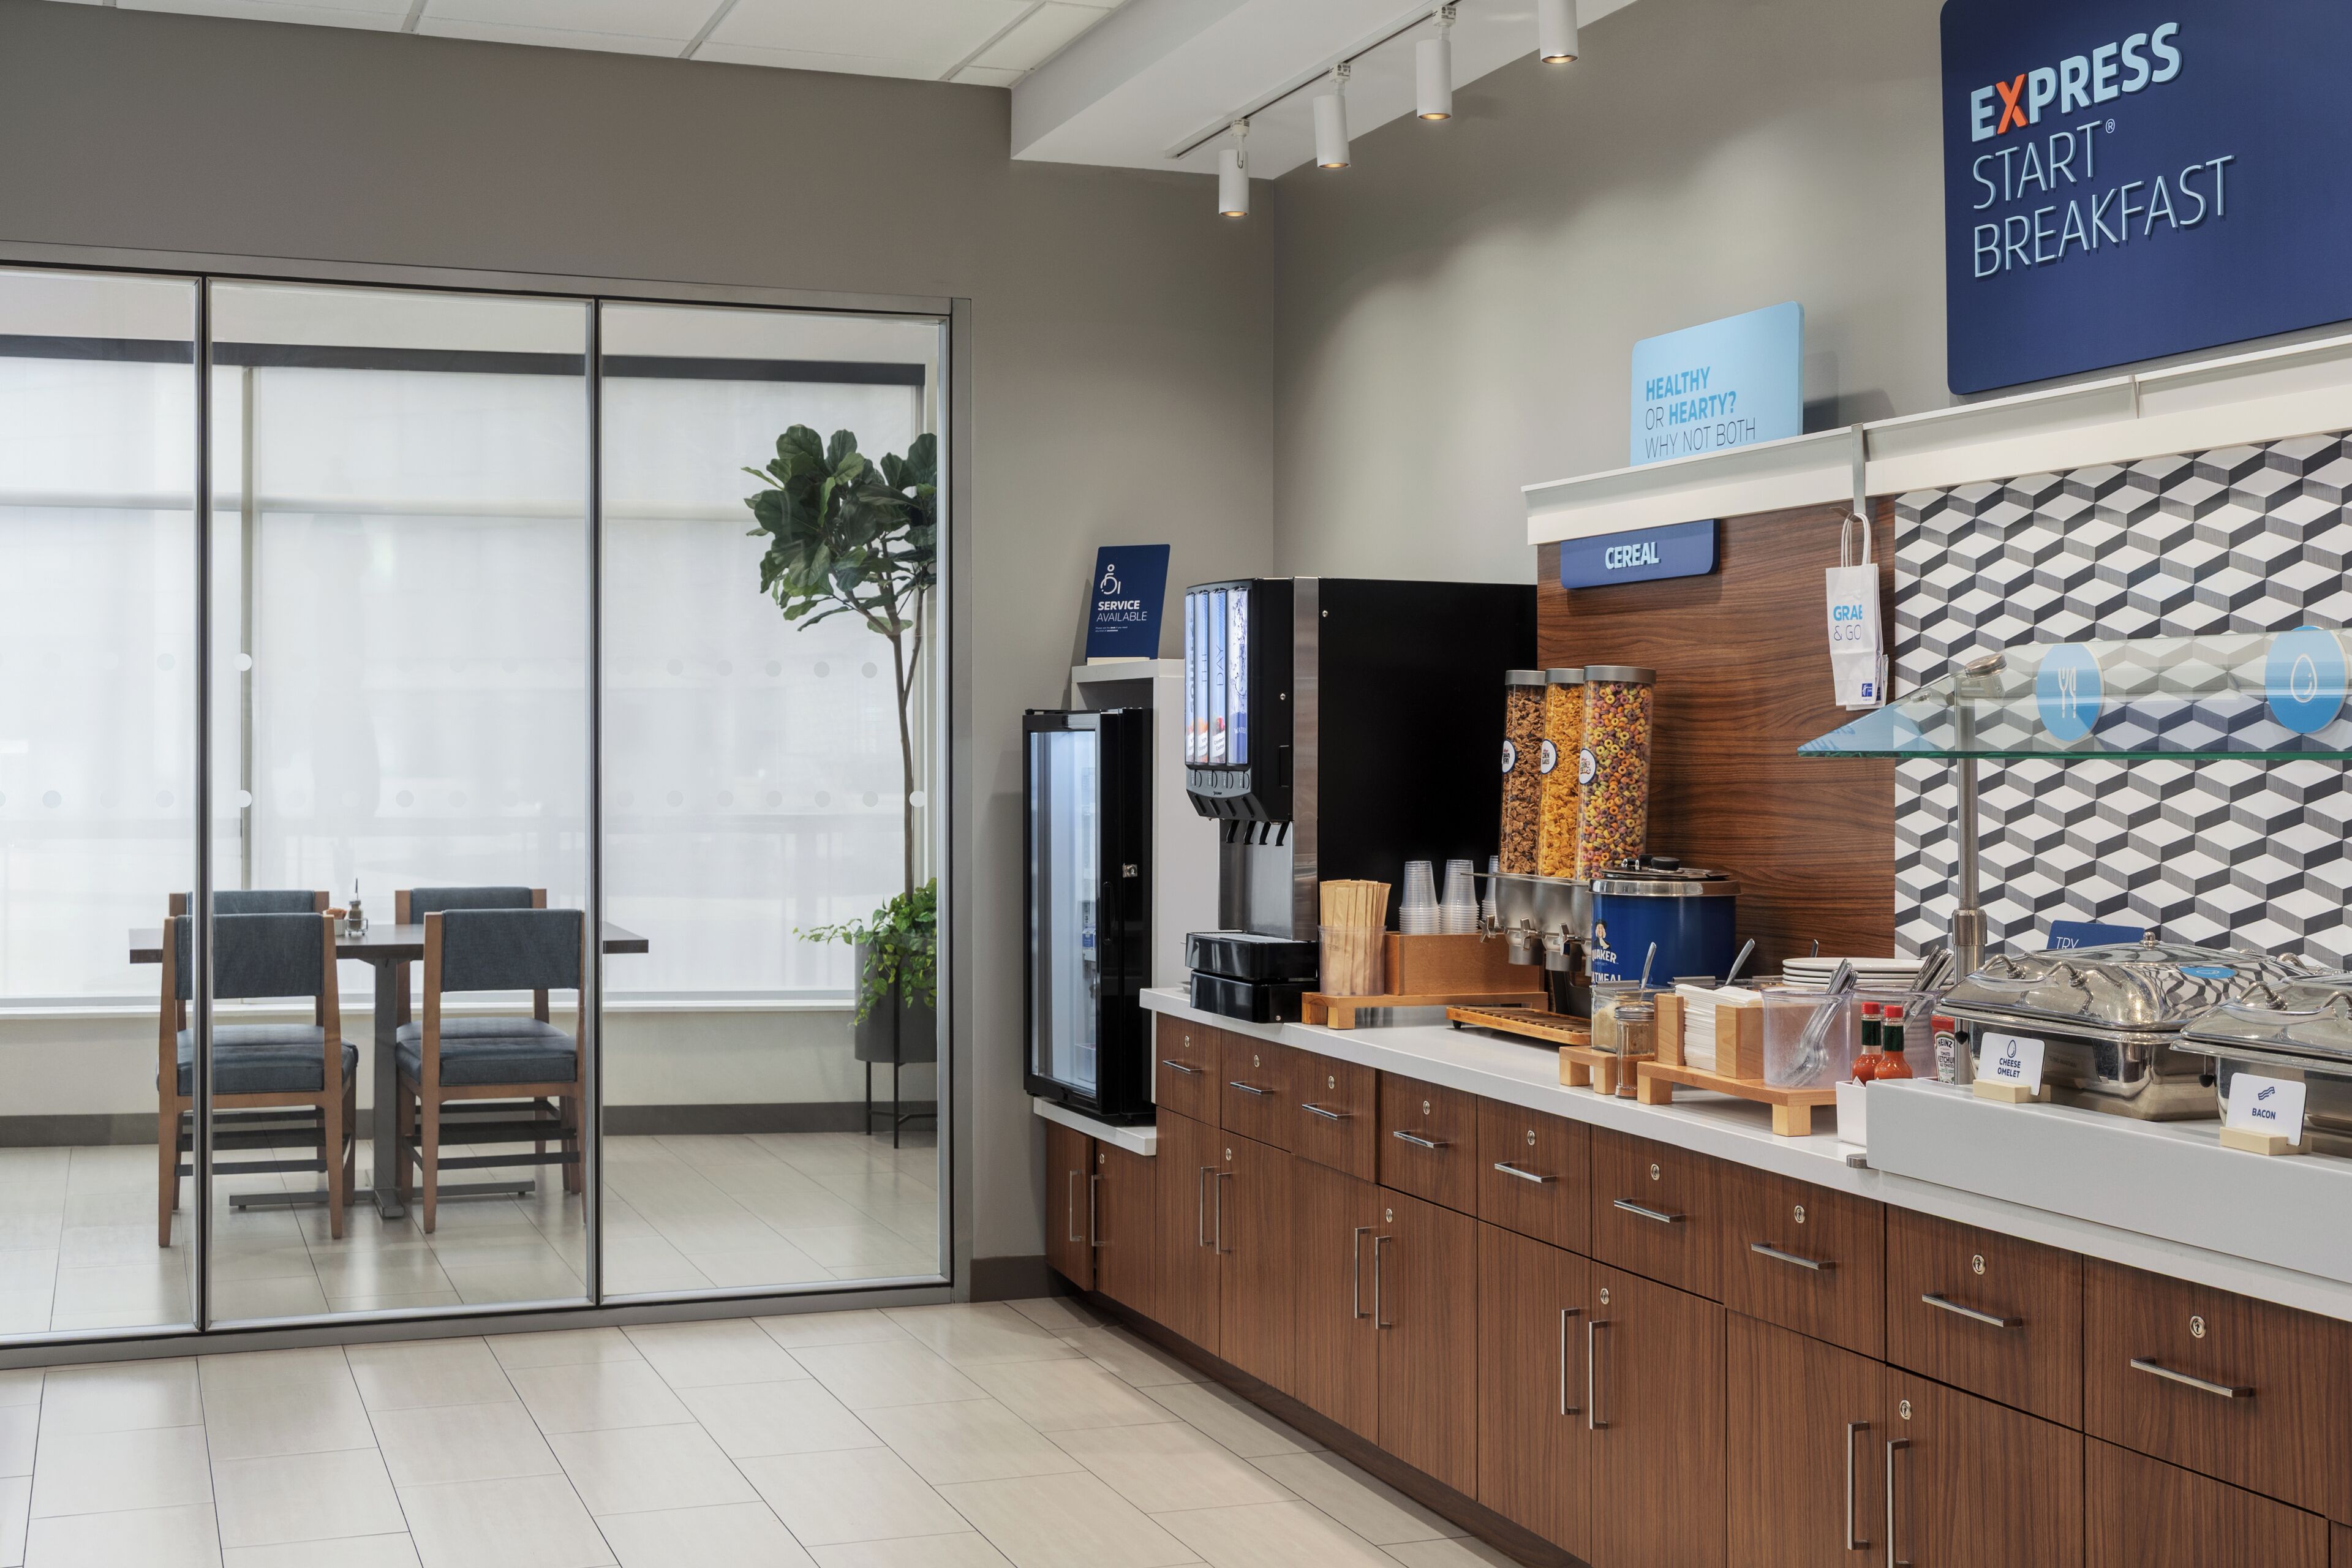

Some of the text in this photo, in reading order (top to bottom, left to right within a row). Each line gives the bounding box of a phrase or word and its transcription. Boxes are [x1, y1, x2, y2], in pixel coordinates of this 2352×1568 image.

[1970, 22, 2182, 142] EXPRESS
[1974, 155, 2234, 277] BREAKFAST
[1646, 366, 1710, 401] HEALTHY
[1645, 391, 1736, 430] OR HEARTY?
[1645, 417, 1755, 459] WHY NOT BOTH
[1605, 541, 1660, 570] CEREAL
[1098, 600, 1140, 611] SERVICE
[1096, 611, 1147, 622] AVAILABLE
[1834, 625, 1861, 641] & GO
[1937, 1038, 1953, 1049] HEINZ
[1999, 1058, 2021, 1068] CHEESE
[1997, 1067, 2020, 1078] OMELET
[2252, 1107, 2276, 1120] BACON
